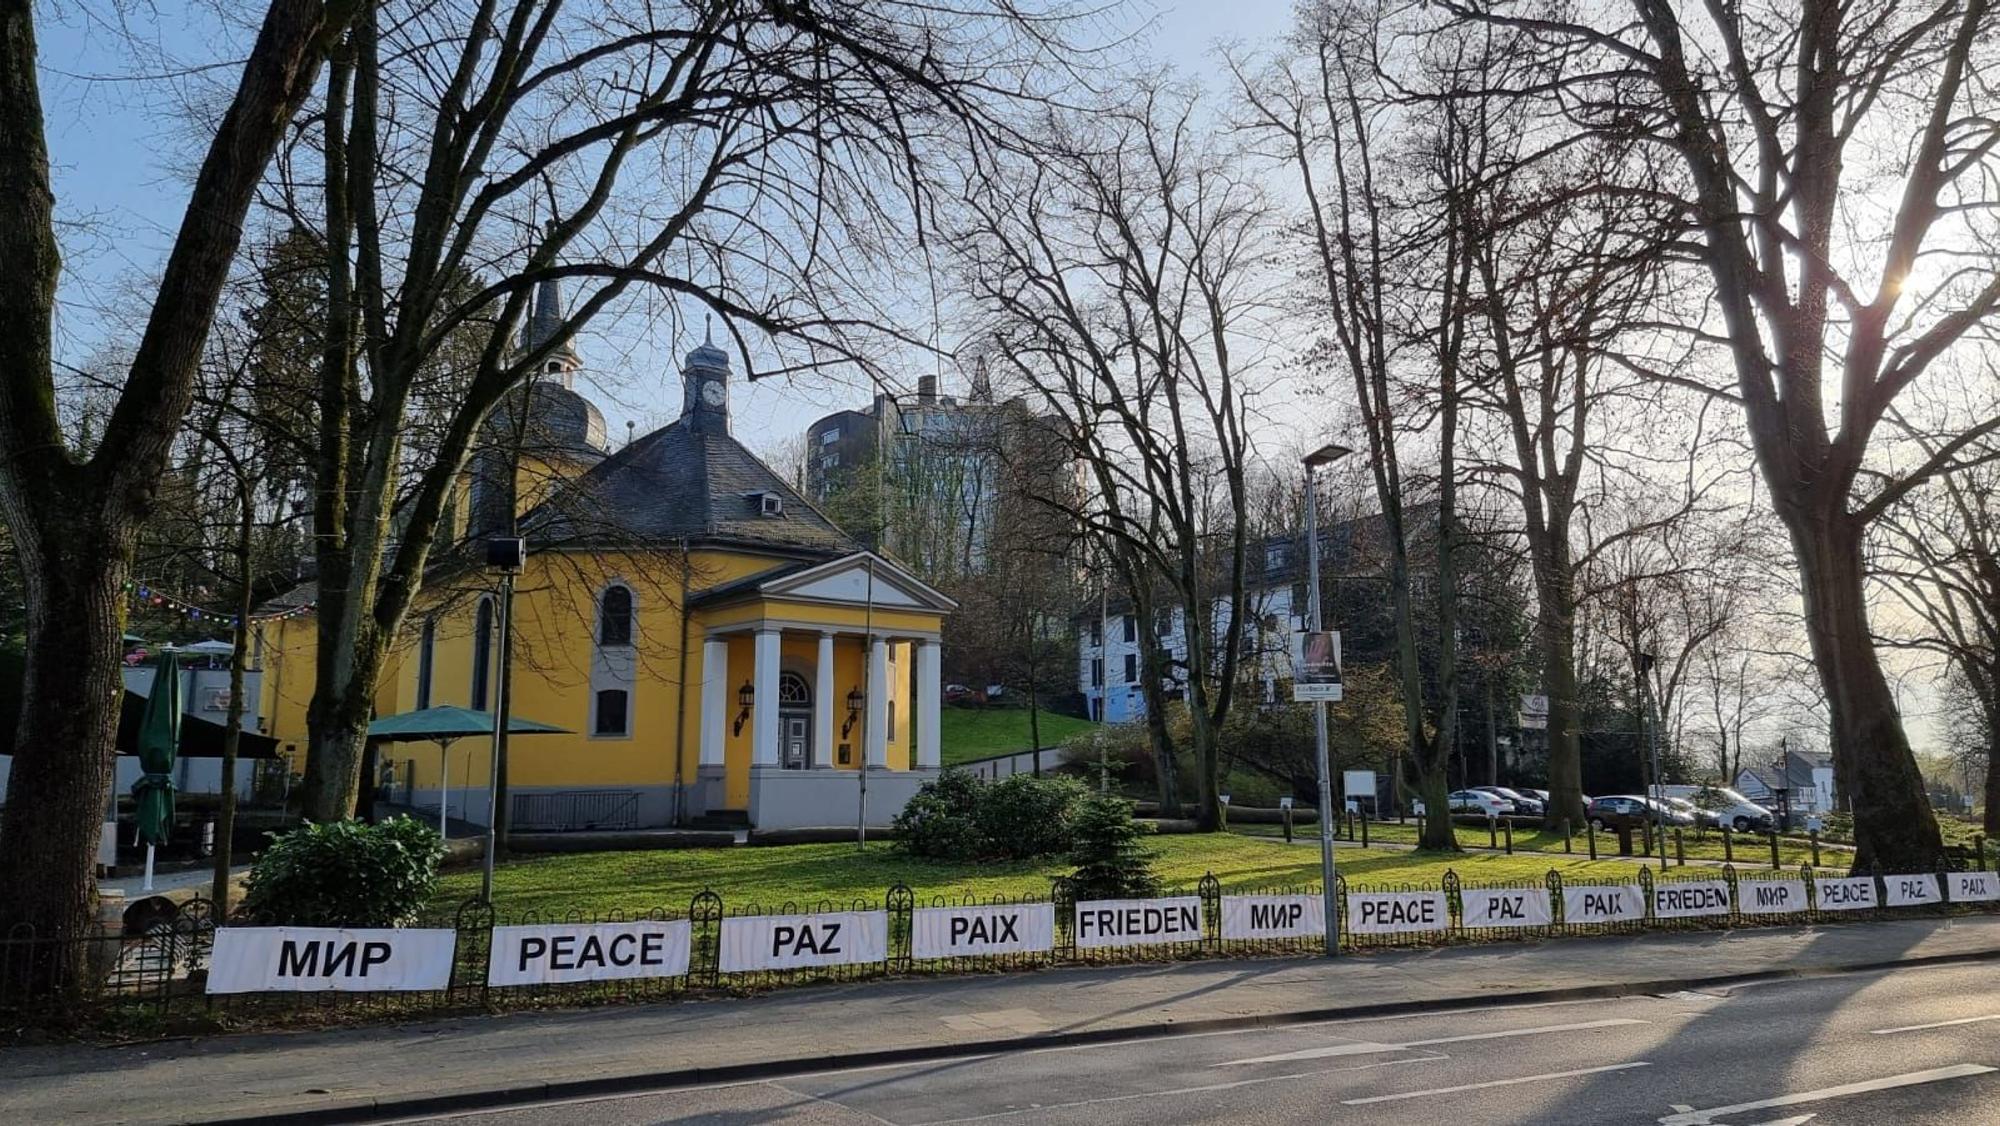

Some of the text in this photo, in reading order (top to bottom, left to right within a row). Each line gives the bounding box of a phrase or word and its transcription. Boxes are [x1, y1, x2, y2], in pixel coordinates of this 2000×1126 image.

[1756, 886, 1788, 906] МИР
[1823, 883, 1869, 903] PEACE
[1901, 881, 1926, 898] PAZ
[1961, 877, 1986, 895] PAIX
[1488, 897, 1525, 919] PAZ
[1584, 893, 1623, 915] PAIX
[1656, 888, 1728, 911] FRIEDEN
[1079, 906, 1198, 938] FRIEDEN
[1251, 904, 1302, 929] МИР
[1361, 900, 1435, 925] PEACE
[773, 924, 841, 957] PAZ
[950, 914, 1019, 946] PAIX
[278, 940, 392, 977] МИР
[519, 933, 665, 972] PEACE
